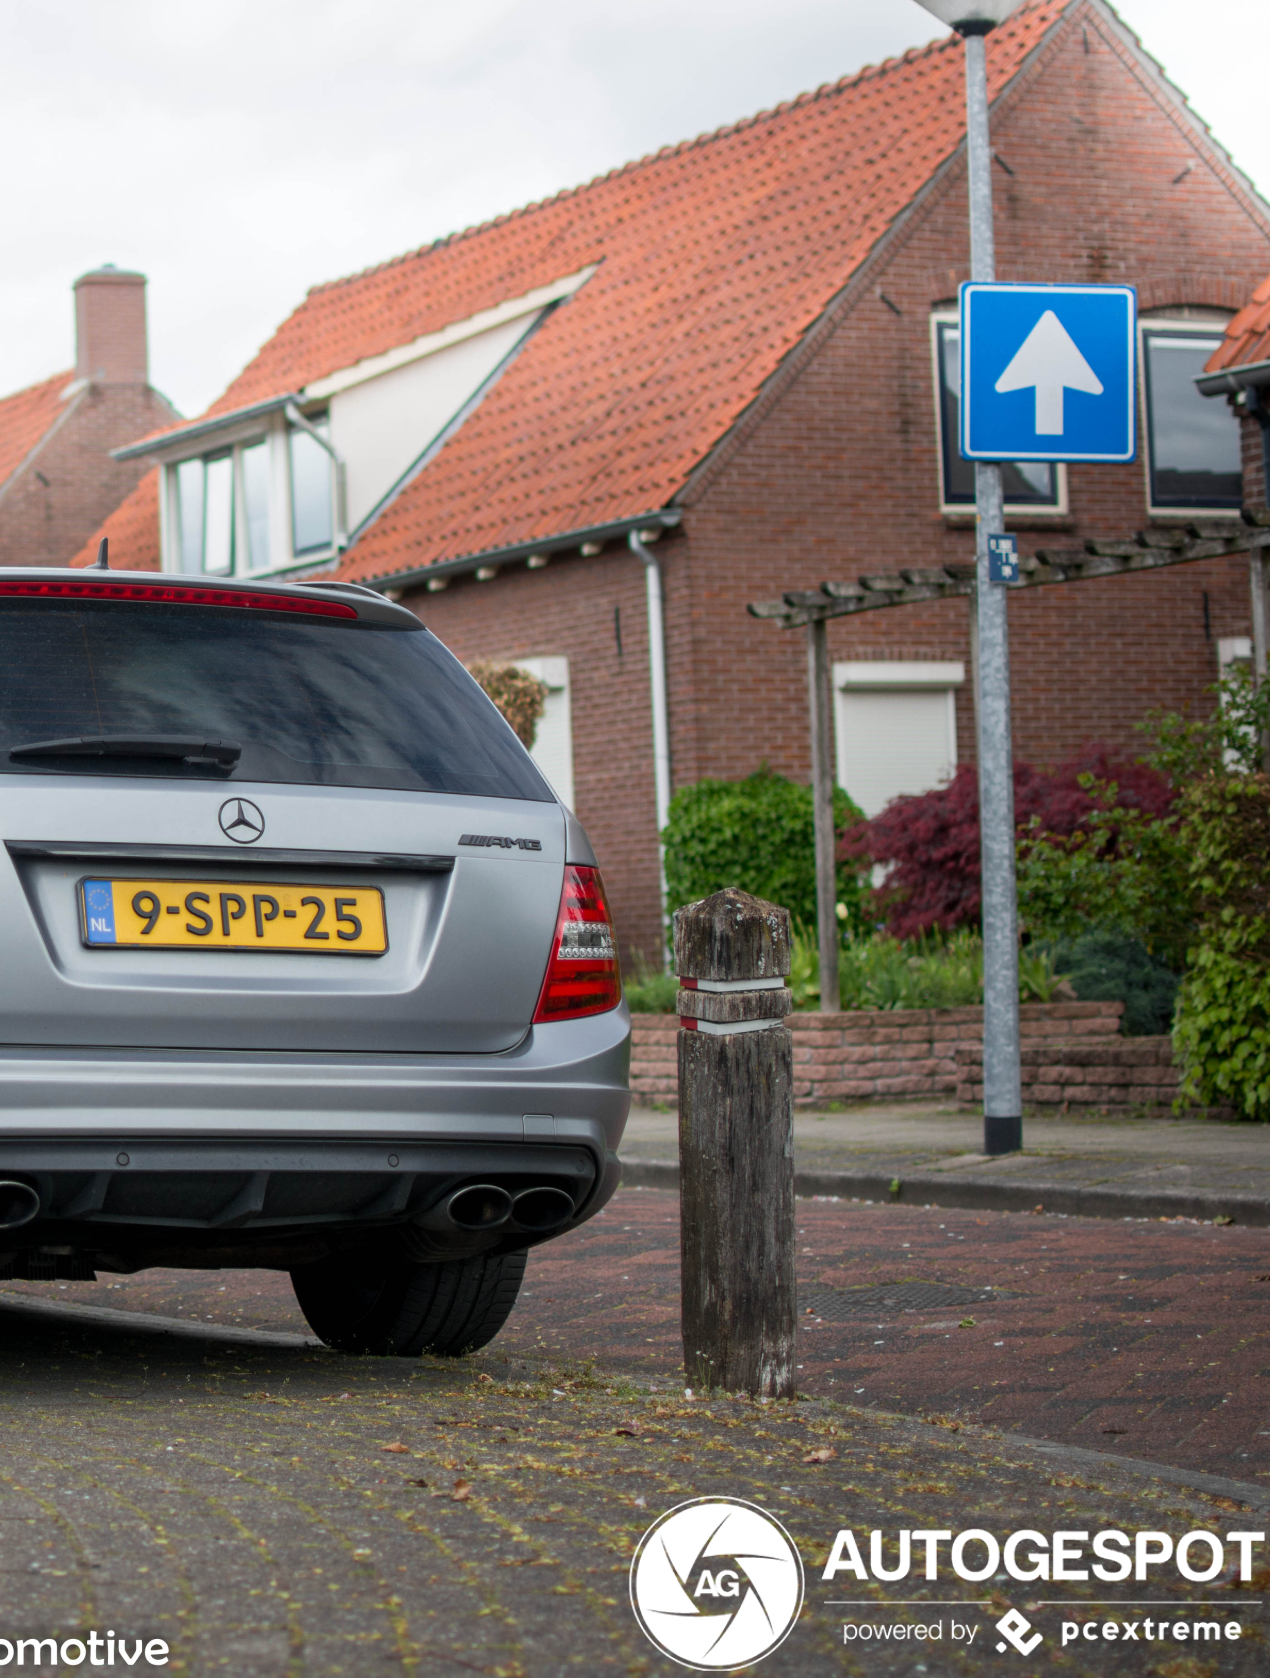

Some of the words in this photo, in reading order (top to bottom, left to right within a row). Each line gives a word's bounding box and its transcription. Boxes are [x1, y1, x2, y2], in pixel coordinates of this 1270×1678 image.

[486, 836, 542, 851] AMG
[131, 890, 363, 941] 9-SPP-25
[90, 918, 112, 932] NL
